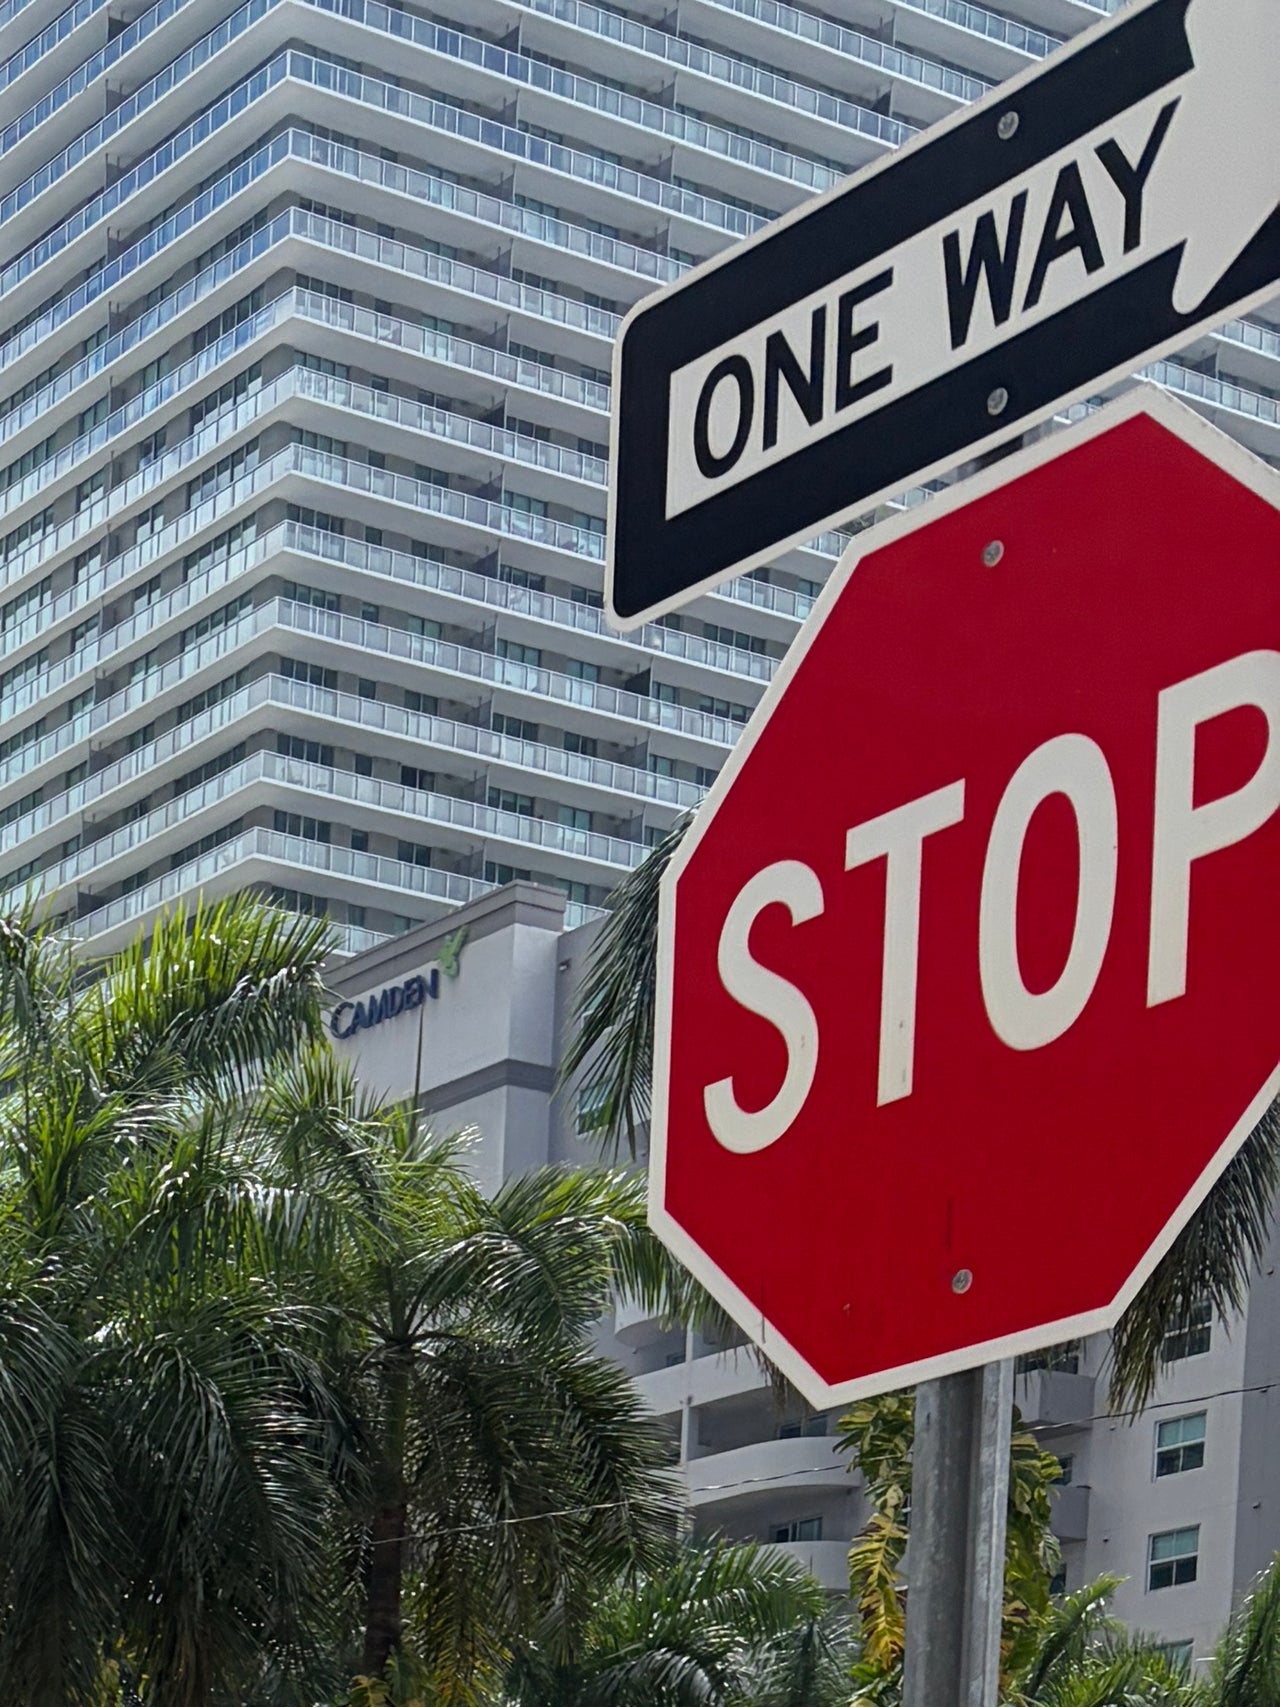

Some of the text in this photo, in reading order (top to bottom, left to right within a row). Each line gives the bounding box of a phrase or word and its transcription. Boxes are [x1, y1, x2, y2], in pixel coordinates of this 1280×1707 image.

[693, 95, 1183, 480] ONE WAY
[330, 968, 440, 1040] CAMDEN
[703, 648, 1280, 1155] STOP
